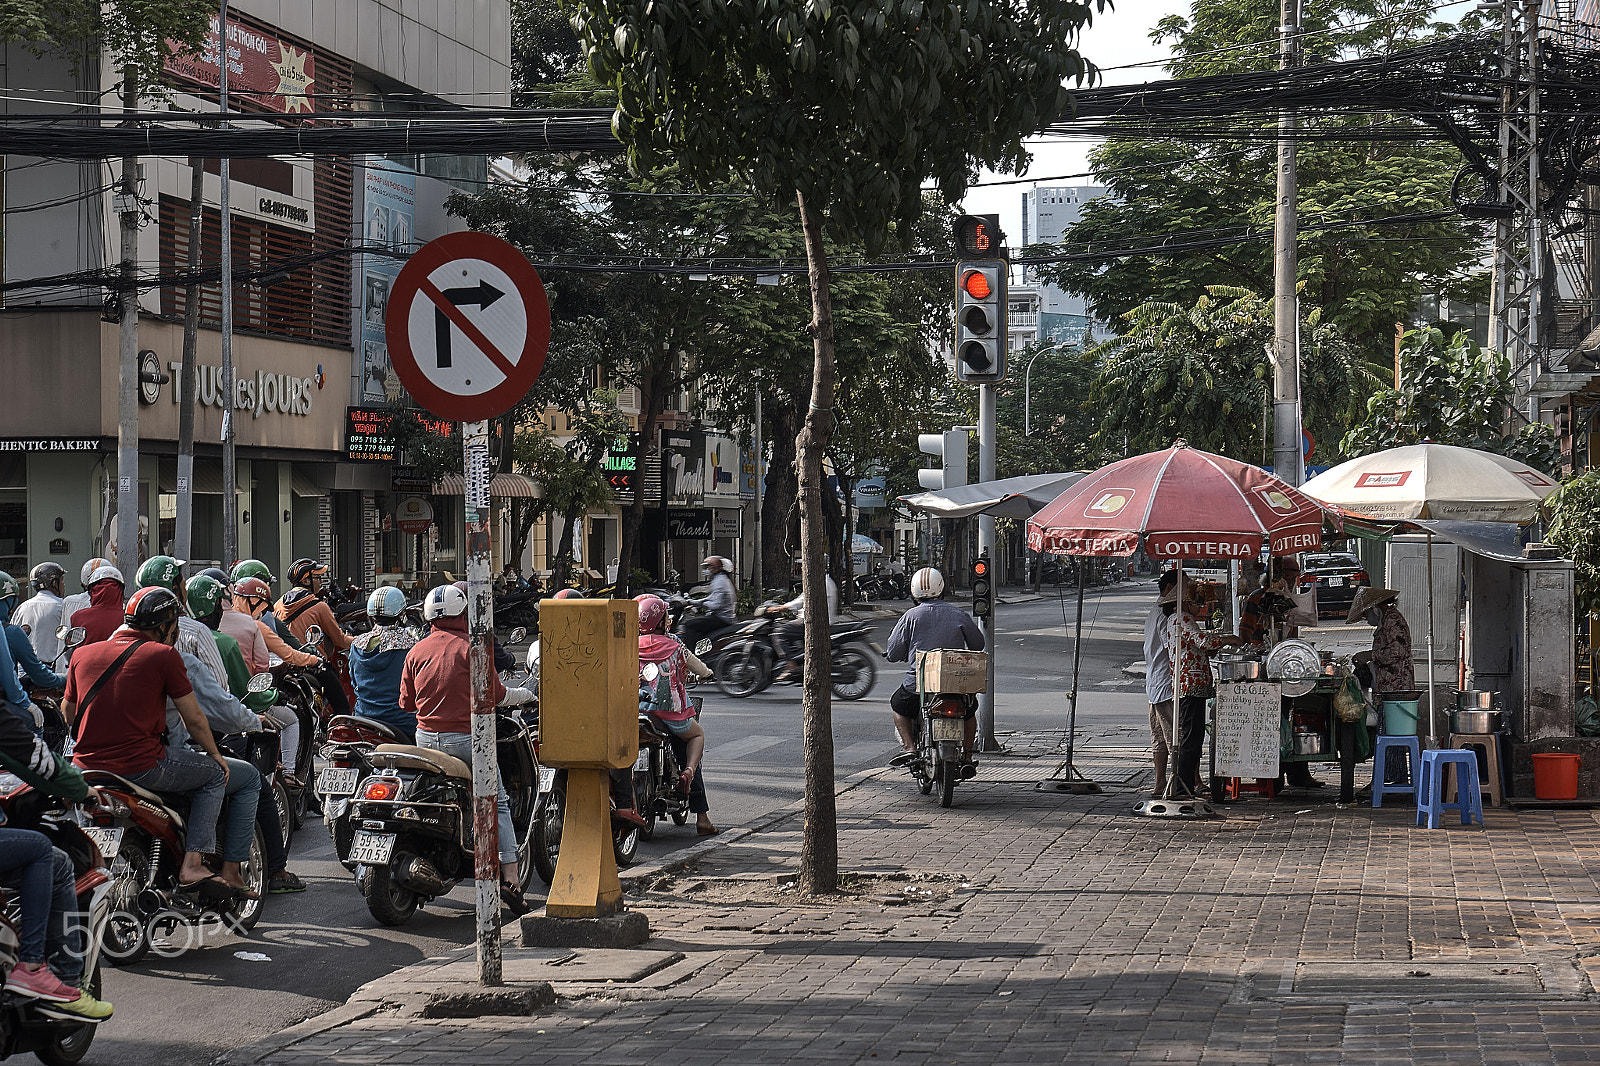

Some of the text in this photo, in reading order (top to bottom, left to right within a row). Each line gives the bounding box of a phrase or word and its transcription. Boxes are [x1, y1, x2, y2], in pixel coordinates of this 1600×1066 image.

[976, 224, 989, 250] 6
[254, 369, 313, 420] JOURS
[49, 440, 100, 450] BAKERY
[669, 519, 710, 537] Thanh
[1050, 537, 1130, 552] LOTTERIA
[1154, 541, 1252, 556] LOTTERIA
[162, 563, 174, 581] Grab
[206, 583, 218, 600] Grab
[327, 769, 353, 780] 59-S1
[321, 781, 354, 792] 498.82
[360, 834, 388, 849] 59-S2
[352, 847, 388, 862] 570.53
